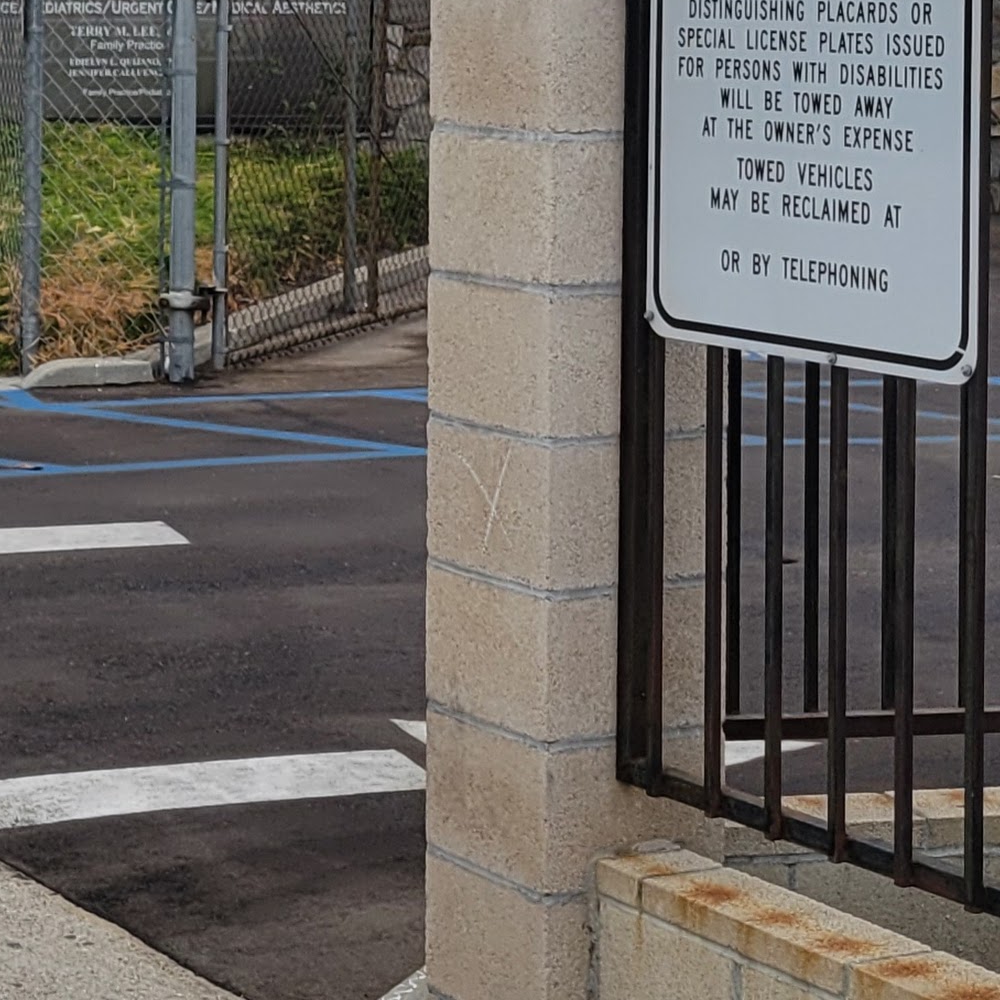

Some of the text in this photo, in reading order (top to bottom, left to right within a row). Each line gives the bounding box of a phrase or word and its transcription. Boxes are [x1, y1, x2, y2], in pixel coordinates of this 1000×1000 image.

[817, 1, 898, 25] PLACARDS
[910, 2, 932, 26] OR
[70, 25, 110, 37] TERRY
[90, 39, 125, 52] Family
[677, 27, 945, 58] SPECIAL LICENSE PLATES ISSUED
[678, 56, 944, 91] FOR PERSONS WITH DISABILITIES
[720, 87, 894, 120] WILL BE TOWED AWAY
[701, 116, 914, 153] AT THE OWNER'S EXPENSE
[736, 157, 874, 193] TOWED VEHICLES
[710, 187, 902, 229] MAY BE RECLAIMED AT
[720, 249, 890, 294] OR BY TELEPHONING
